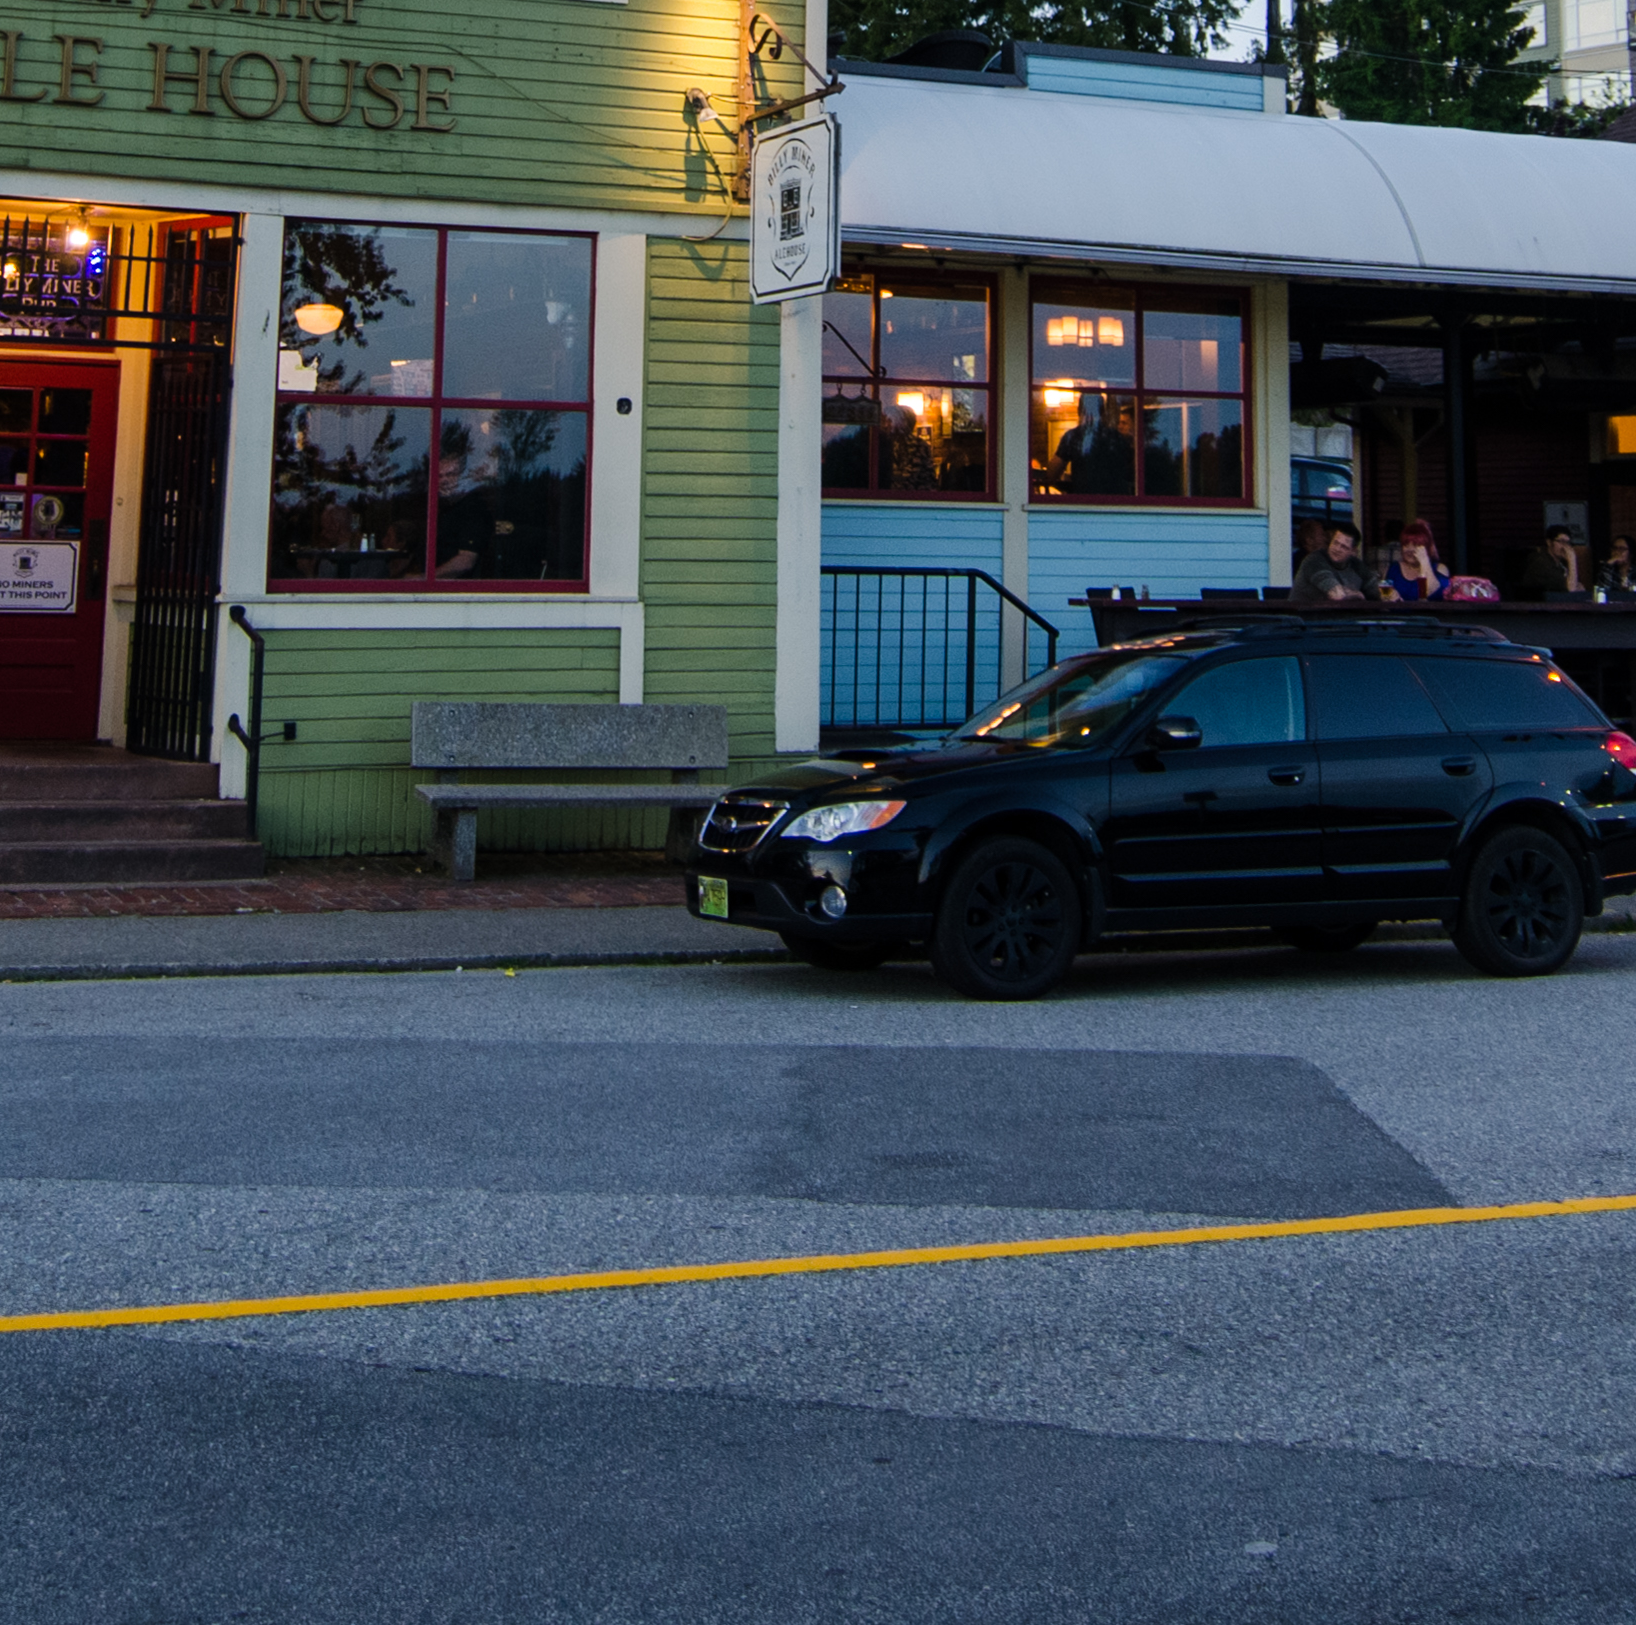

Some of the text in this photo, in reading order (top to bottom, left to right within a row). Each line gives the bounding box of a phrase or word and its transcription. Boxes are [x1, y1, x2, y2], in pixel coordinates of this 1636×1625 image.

[144, 41, 459, 133] HOUSE
[767, 146, 816, 187] BILLY MINER
[774, 242, 806, 260] ALEHOUSE
[12, 580, 54, 589] MINERS
[7, 591, 33, 599] THIS
[34, 591, 68, 599] POINT
